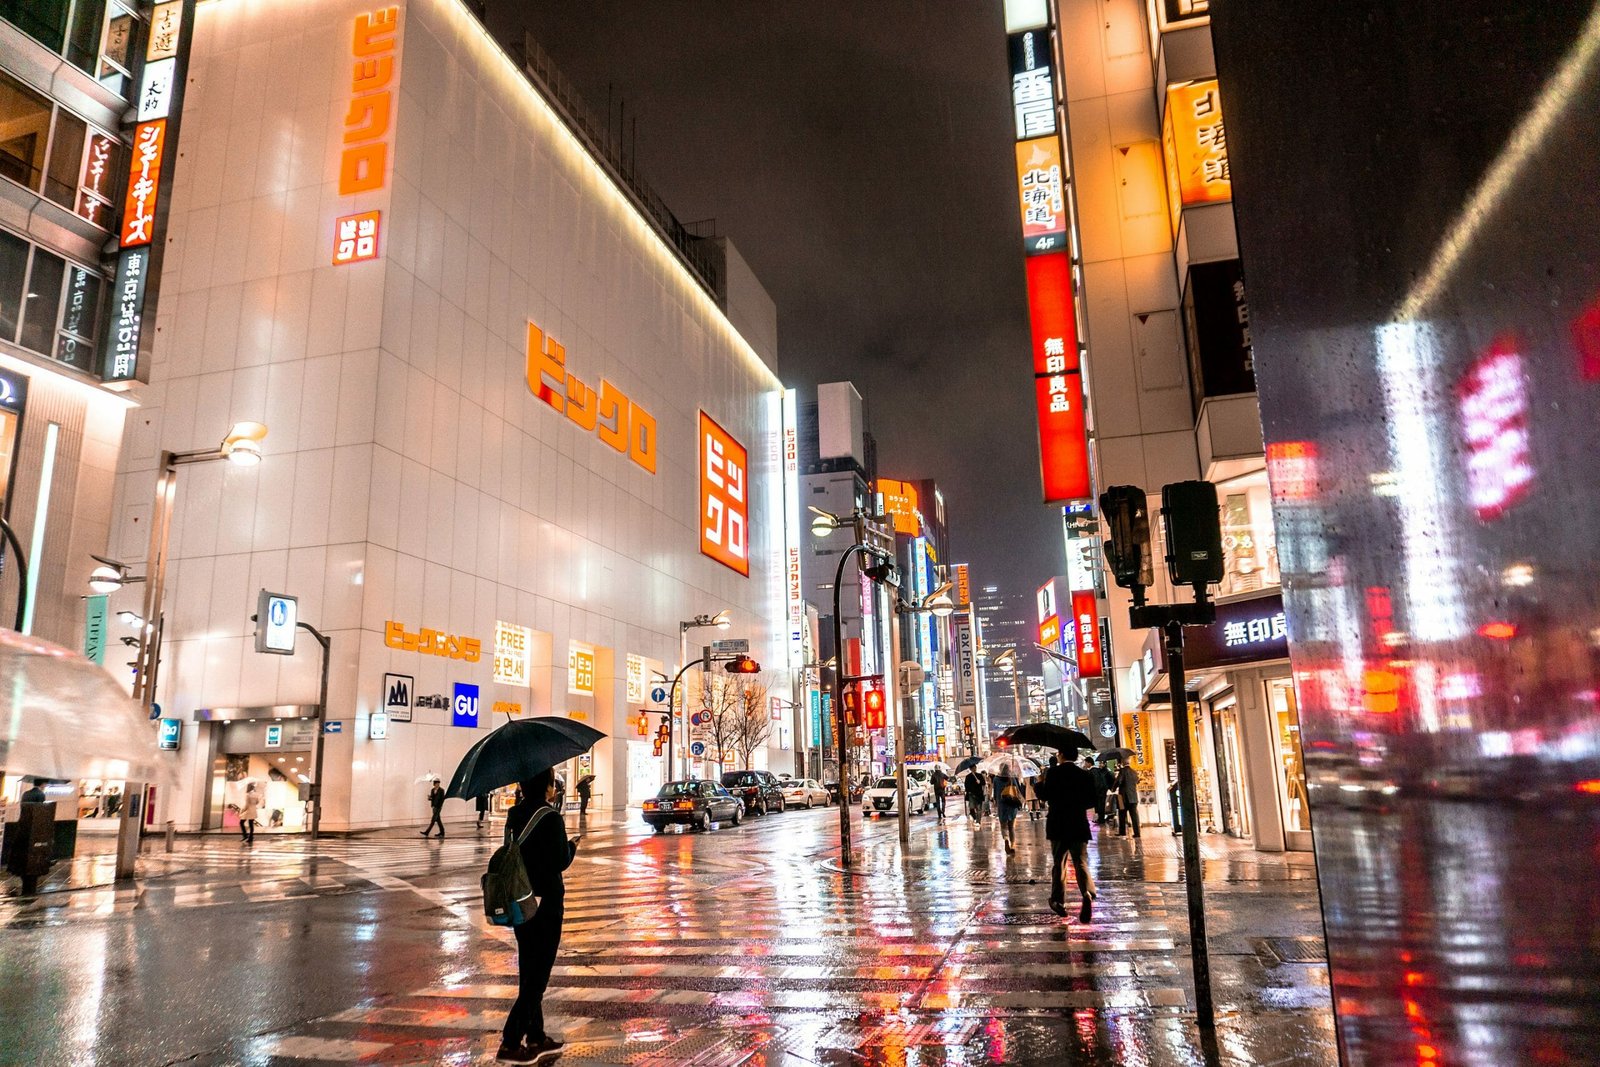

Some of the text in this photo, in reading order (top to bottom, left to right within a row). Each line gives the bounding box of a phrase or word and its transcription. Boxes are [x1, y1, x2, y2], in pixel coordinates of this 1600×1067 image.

[339, 6, 399, 196] ビックロ
[125, 127, 160, 244] シェーキーズ
[1024, 171, 1052, 223] 北海道
[1035, 237, 1054, 250] 4F
[527, 321, 657, 475] ビックロ
[1045, 338, 1069, 412] 無印良品
[501, 630, 525, 650] FREE
[961, 627, 971, 677] Tax Free
[455, 694, 478, 716] GU
